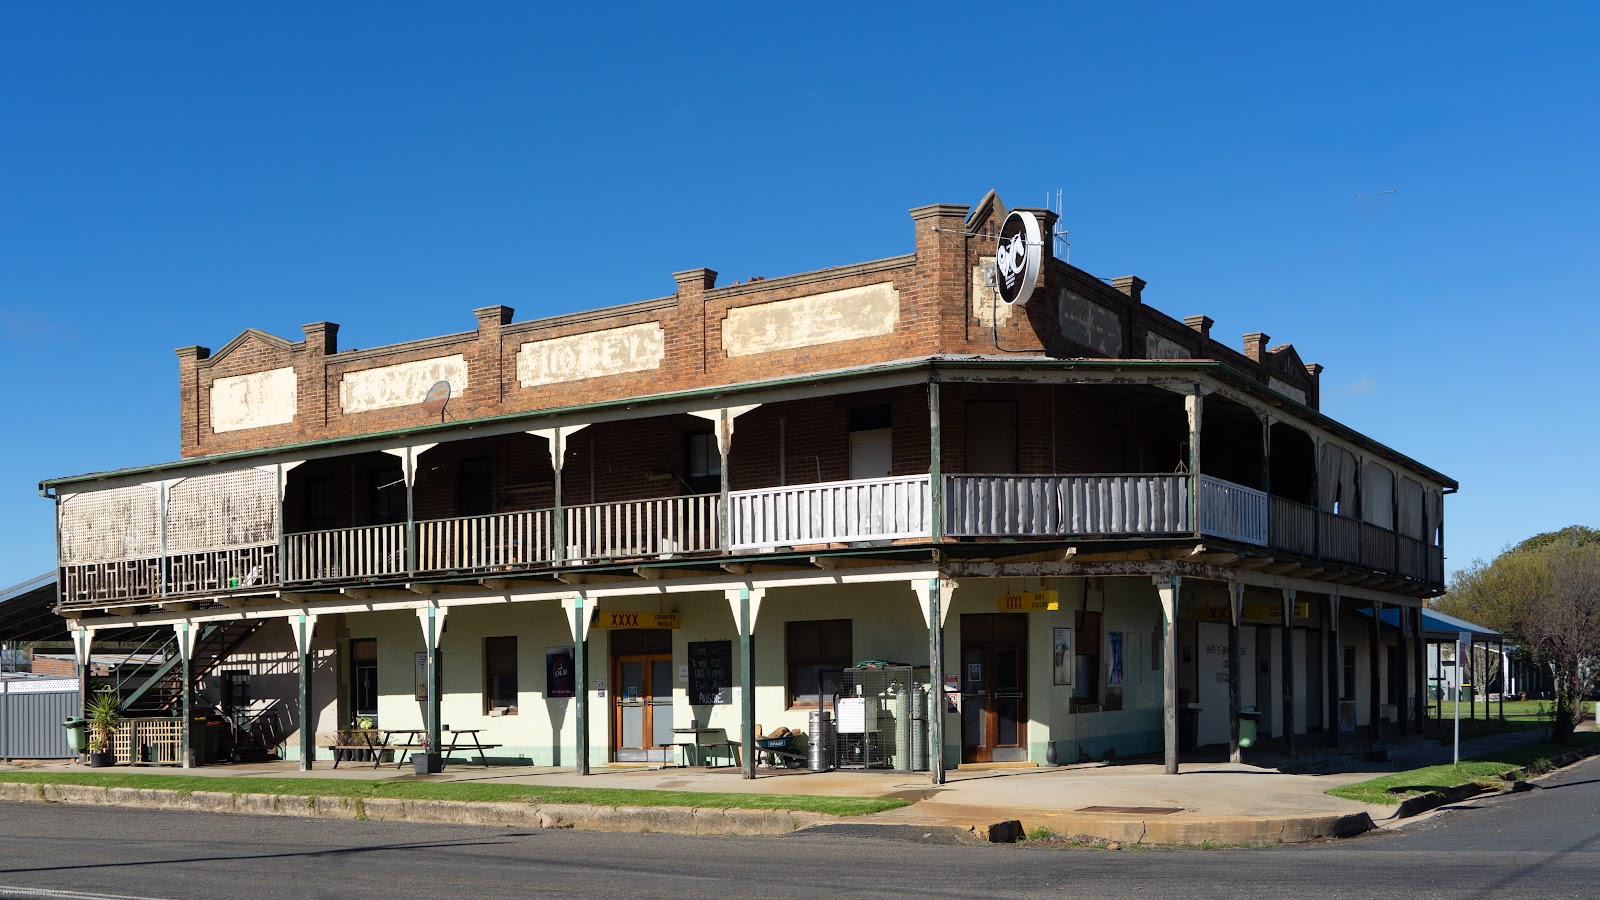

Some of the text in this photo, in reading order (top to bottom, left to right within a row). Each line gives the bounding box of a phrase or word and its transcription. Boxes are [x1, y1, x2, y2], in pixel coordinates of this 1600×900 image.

[521, 331, 660, 382] HOTEL
[1005, 595, 1022, 609] XXXX
[611, 613, 639, 626] XXXX
[1209, 607, 1246, 619] XXX
[554, 669, 568, 677] OLD
